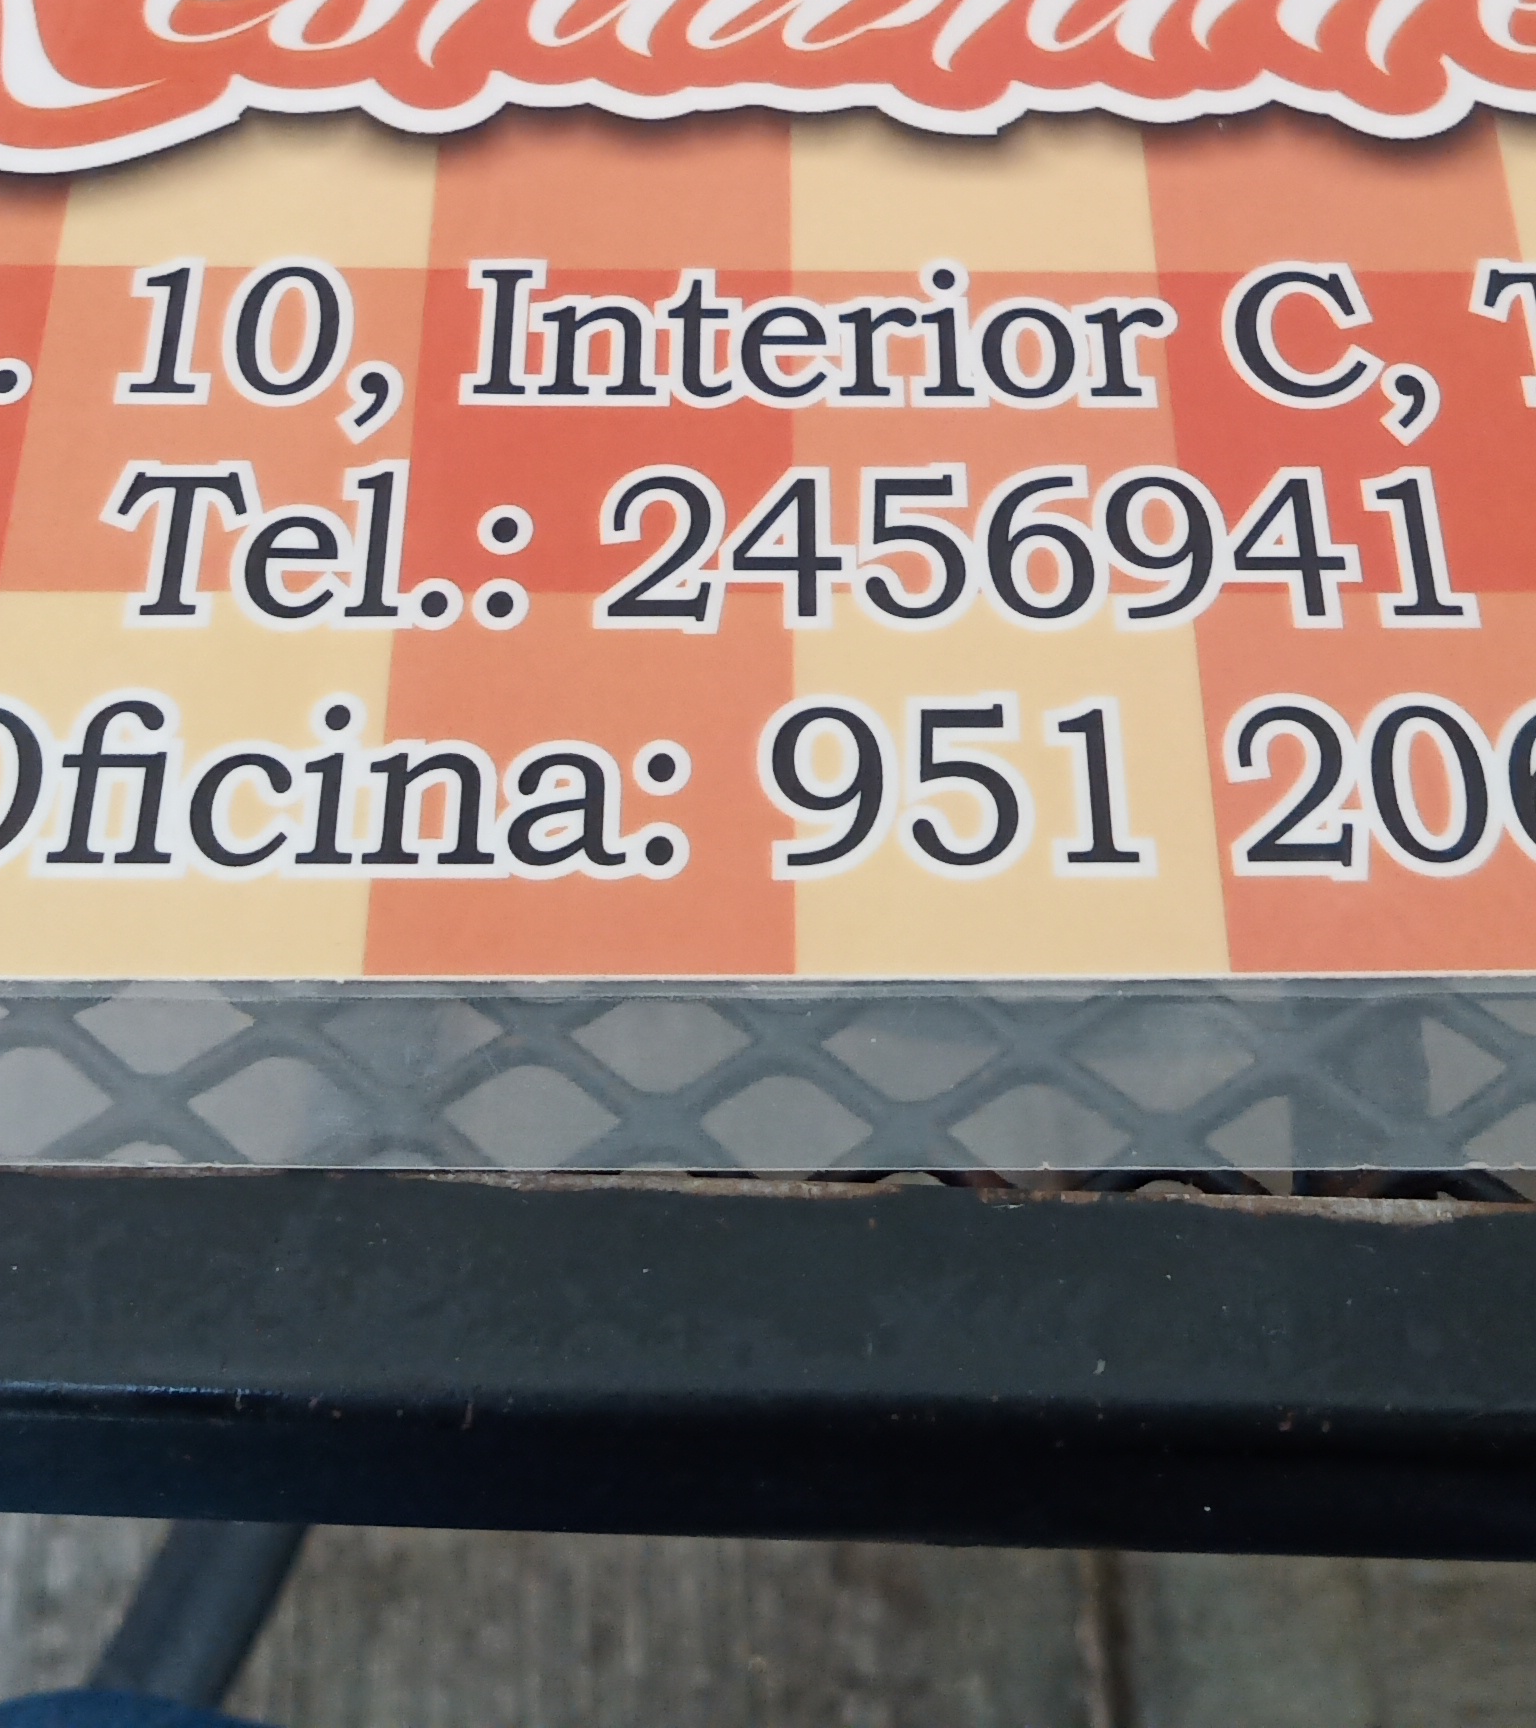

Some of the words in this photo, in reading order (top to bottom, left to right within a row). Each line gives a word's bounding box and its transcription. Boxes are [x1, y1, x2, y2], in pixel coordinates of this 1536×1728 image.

[124, 266, 395, 428] 10,
[470, 267, 1166, 402] Interior
[1230, 268, 1437, 431] C,
[112, 466, 526, 624] Tel.:
[605, 469, 1464, 620] 2456941
[768, 704, 1143, 869] 951
